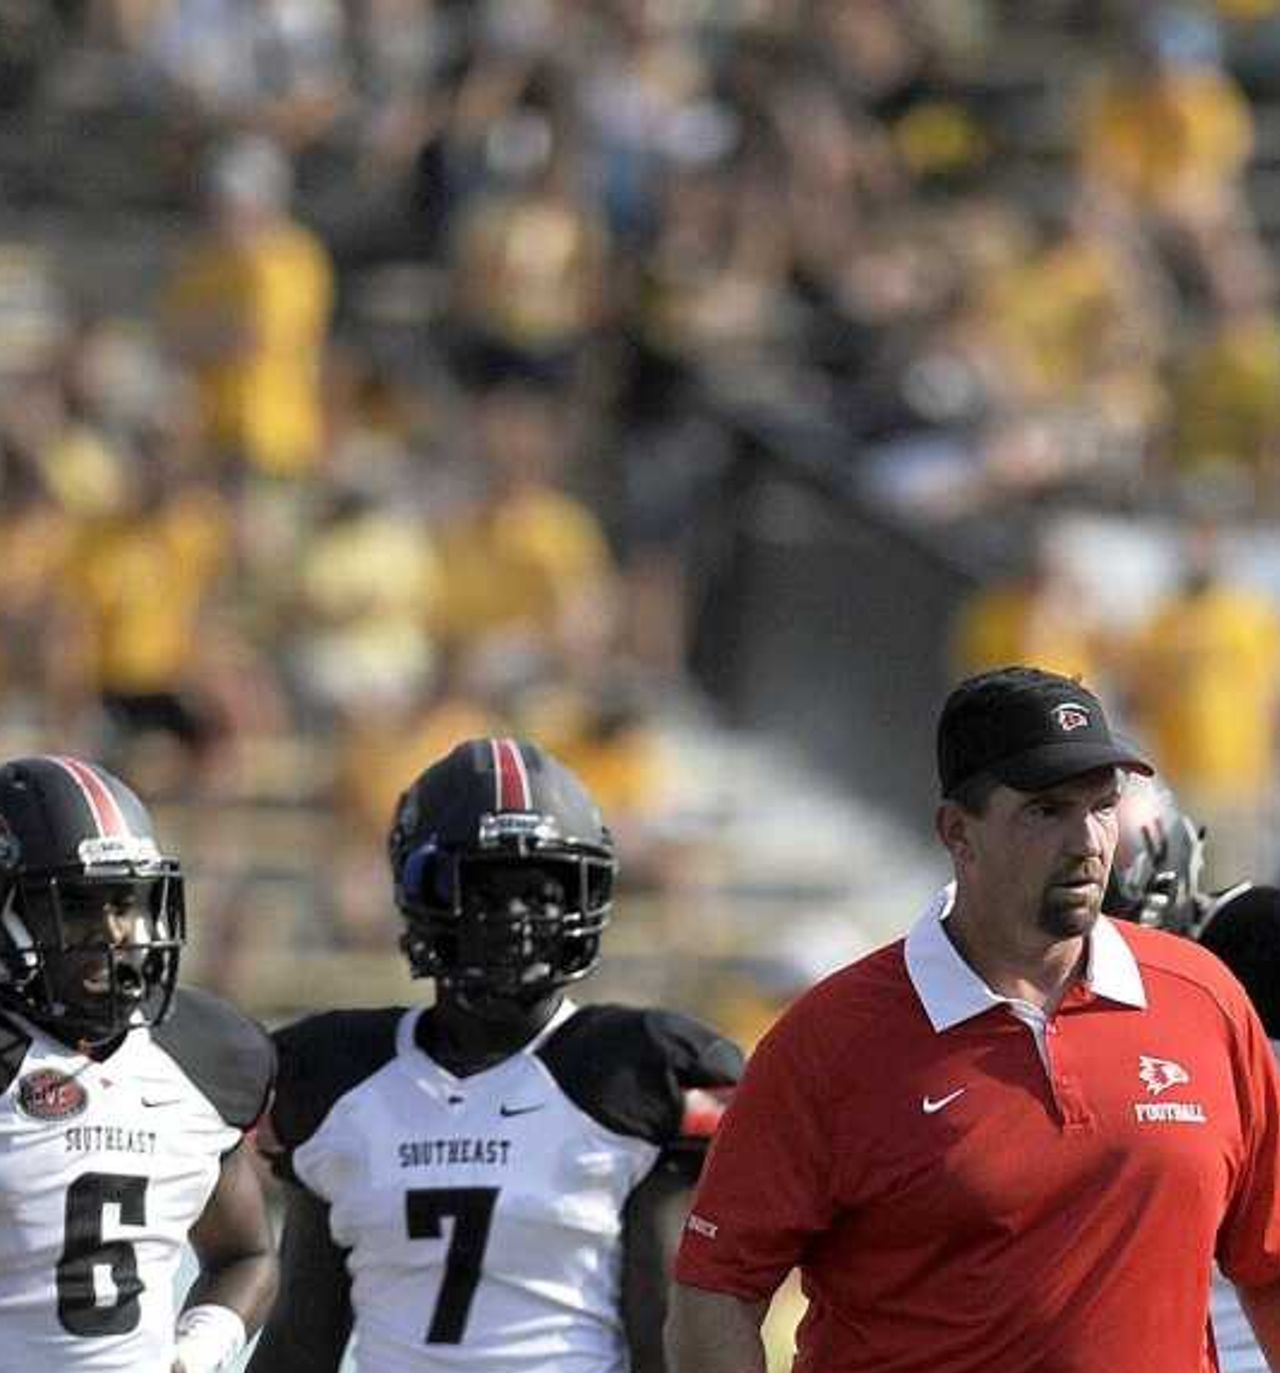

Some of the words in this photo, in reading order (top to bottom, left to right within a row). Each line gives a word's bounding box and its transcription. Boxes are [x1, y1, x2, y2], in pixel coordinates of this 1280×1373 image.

[1135, 1102, 1207, 1122] FOOTBALL
[65, 1126, 157, 1155] SOUTHEAST
[399, 1139, 511, 1168] SOUTHEAST
[55, 1171, 149, 1337] 6
[404, 1186, 503, 1345] 7
